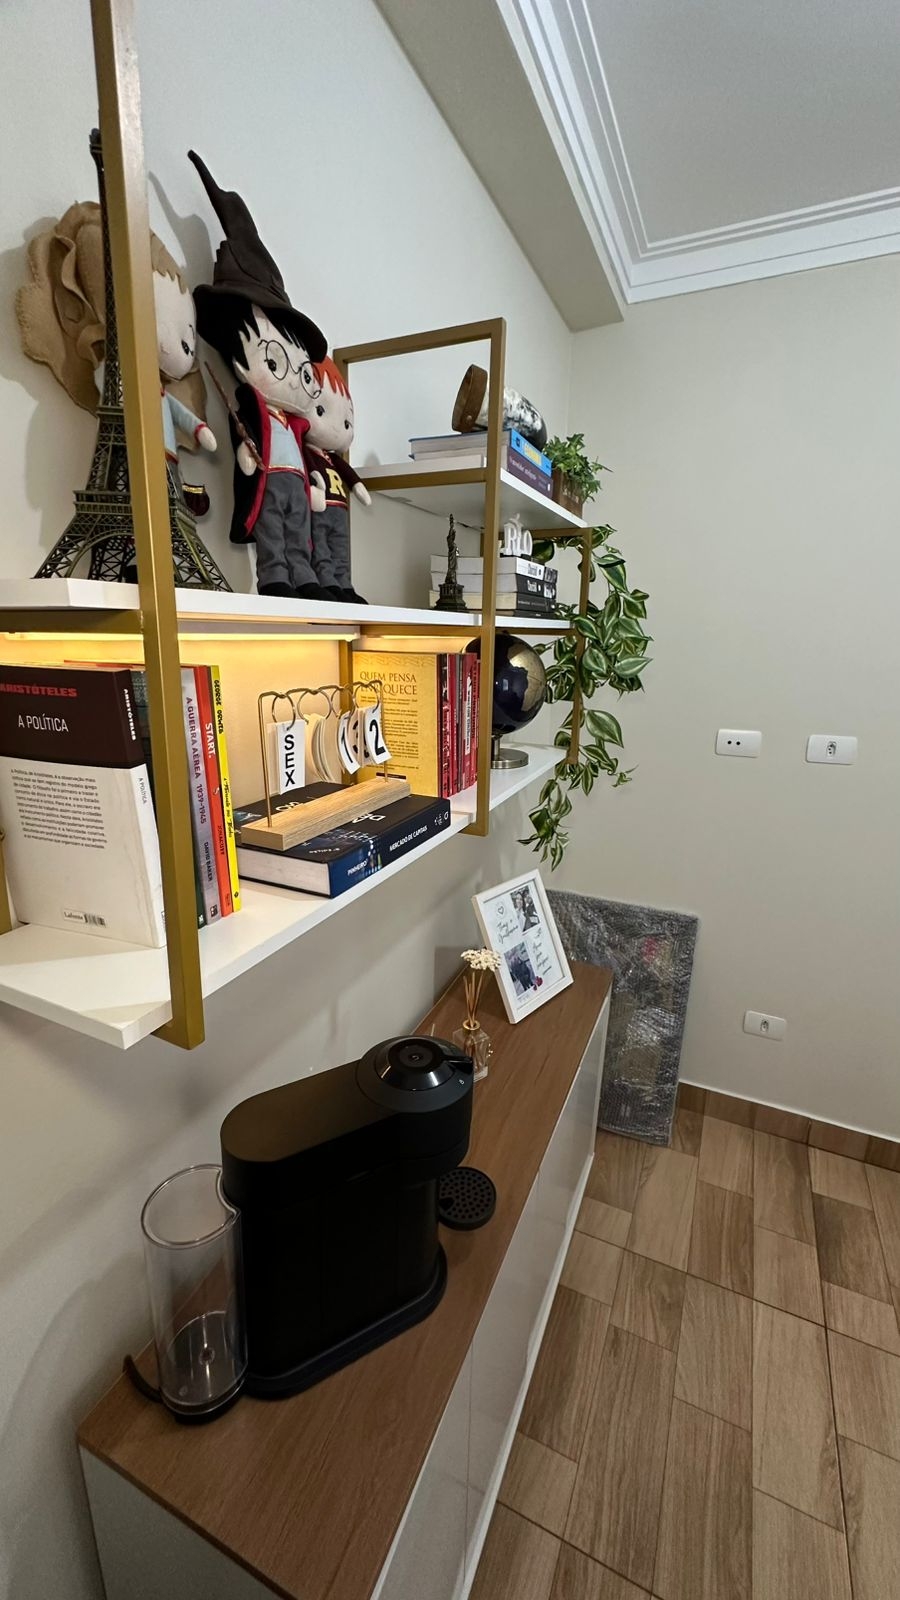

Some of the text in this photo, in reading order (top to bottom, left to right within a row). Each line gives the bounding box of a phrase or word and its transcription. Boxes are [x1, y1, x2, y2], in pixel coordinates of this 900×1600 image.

[326, 468, 346, 498] R
[360, 671, 417, 683] QUEM PENSA
[361, 682, 418, 696] ENRQUECE
[18, 713, 69, 732] A POLÍTICA
[205, 722, 216, 759] START.
[186, 696, 207, 825] A GUERRA AÉREA 1939-1945
[284, 733, 296, 788] SEX
[389, 836, 408, 852] MERCADO
